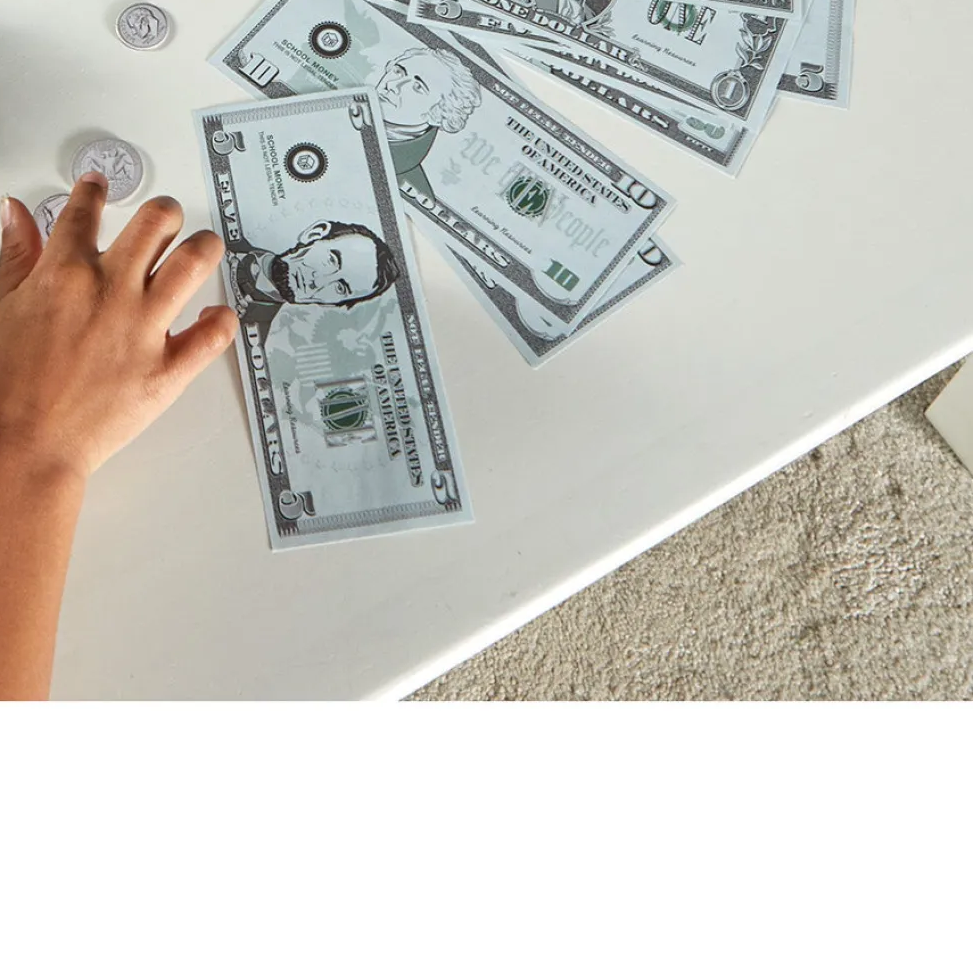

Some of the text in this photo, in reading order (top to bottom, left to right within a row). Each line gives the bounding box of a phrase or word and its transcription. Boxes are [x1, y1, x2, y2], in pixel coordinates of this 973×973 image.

[532, 11, 627, 62] DOLLAR
[238, 50, 280, 89] 10
[280, 39, 339, 82] SCHOOL MONEY
[796, 62, 824, 92] 5
[348, 102, 371, 131] 5
[210, 127, 245, 156] 5
[505, 117, 631, 211] THE UNITED STATES
[266, 135, 285, 199] SCHOOL MONEY
[521, 145, 599, 203] OF AMERICA
[217, 173, 240, 242] FIVE
[610, 171, 660, 212] 10
[394, 181, 515, 268] DOLLARS
[542, 258, 580, 292] 10
[242, 324, 287, 475] DOLLARS
[373, 364, 401, 455] OF AMERICA
[381, 332, 423, 485] THE UNITED STATES
[276, 486, 314, 521] 5
[429, 468, 455, 506] 5
